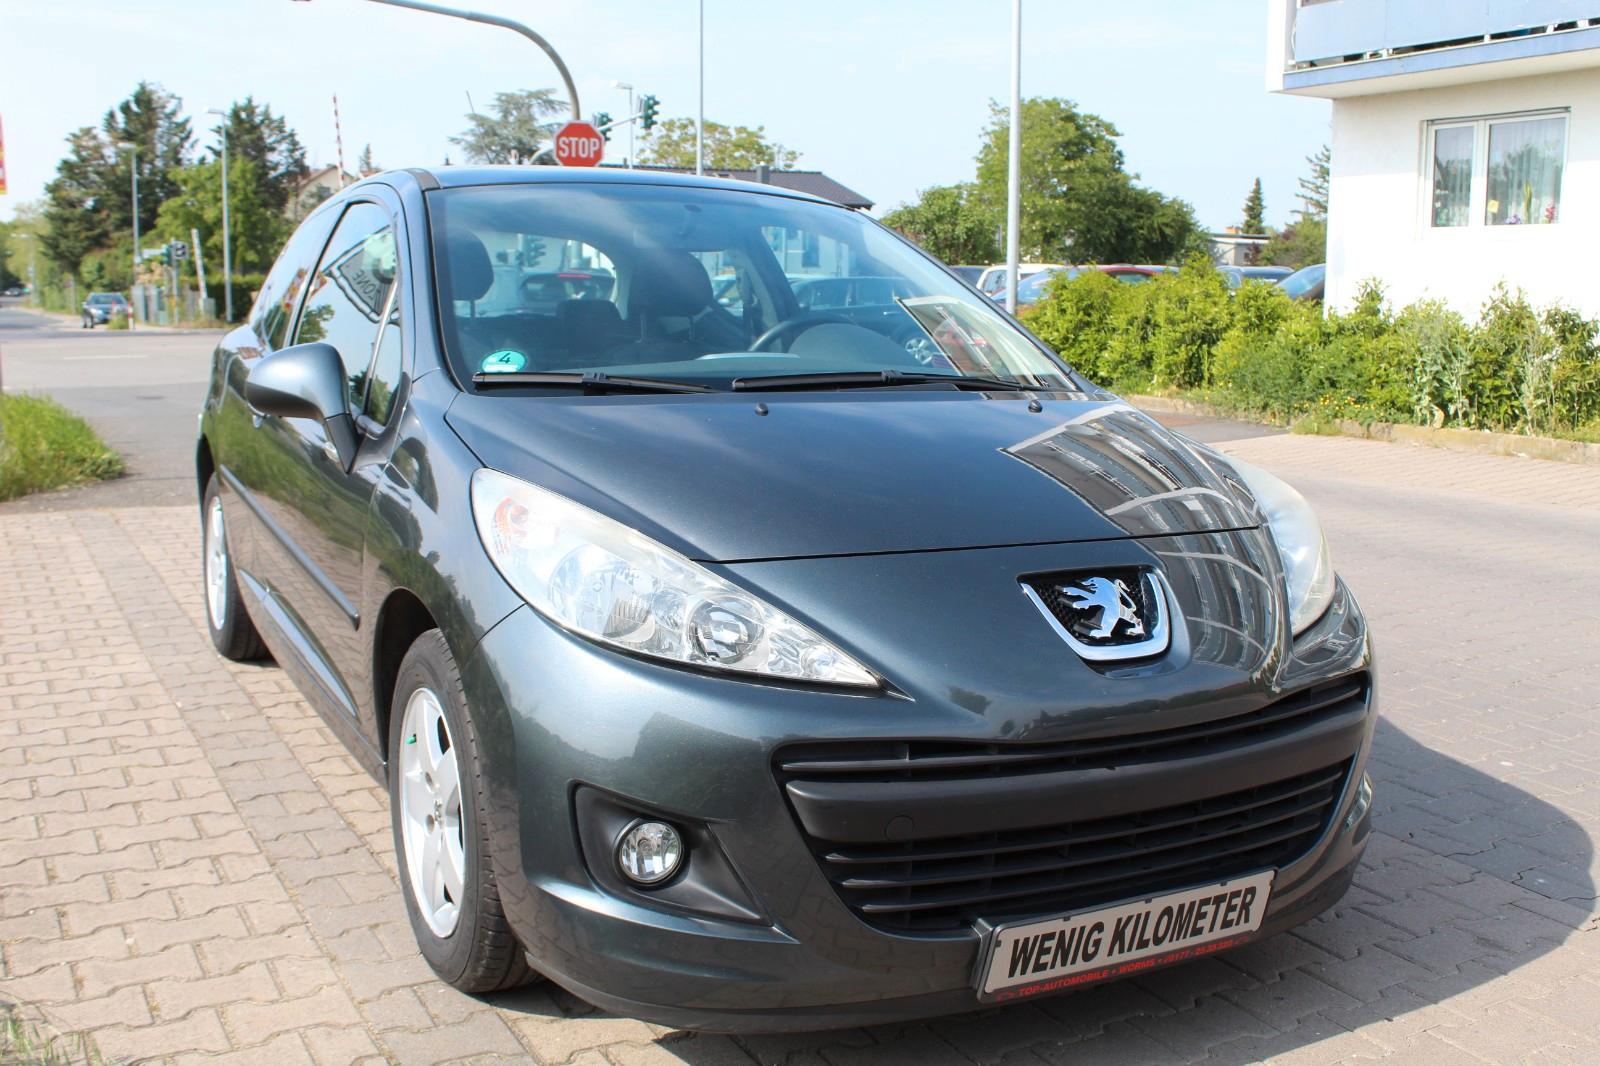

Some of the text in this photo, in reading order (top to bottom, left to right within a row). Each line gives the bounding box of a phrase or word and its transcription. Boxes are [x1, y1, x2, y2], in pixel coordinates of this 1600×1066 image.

[559, 136, 600, 158] STOP
[498, 352, 511, 364] 4
[1008, 886, 1256, 978] WENIG KILOMETER
[1018, 969, 1109, 997] TOP-AUTOMOBILE
